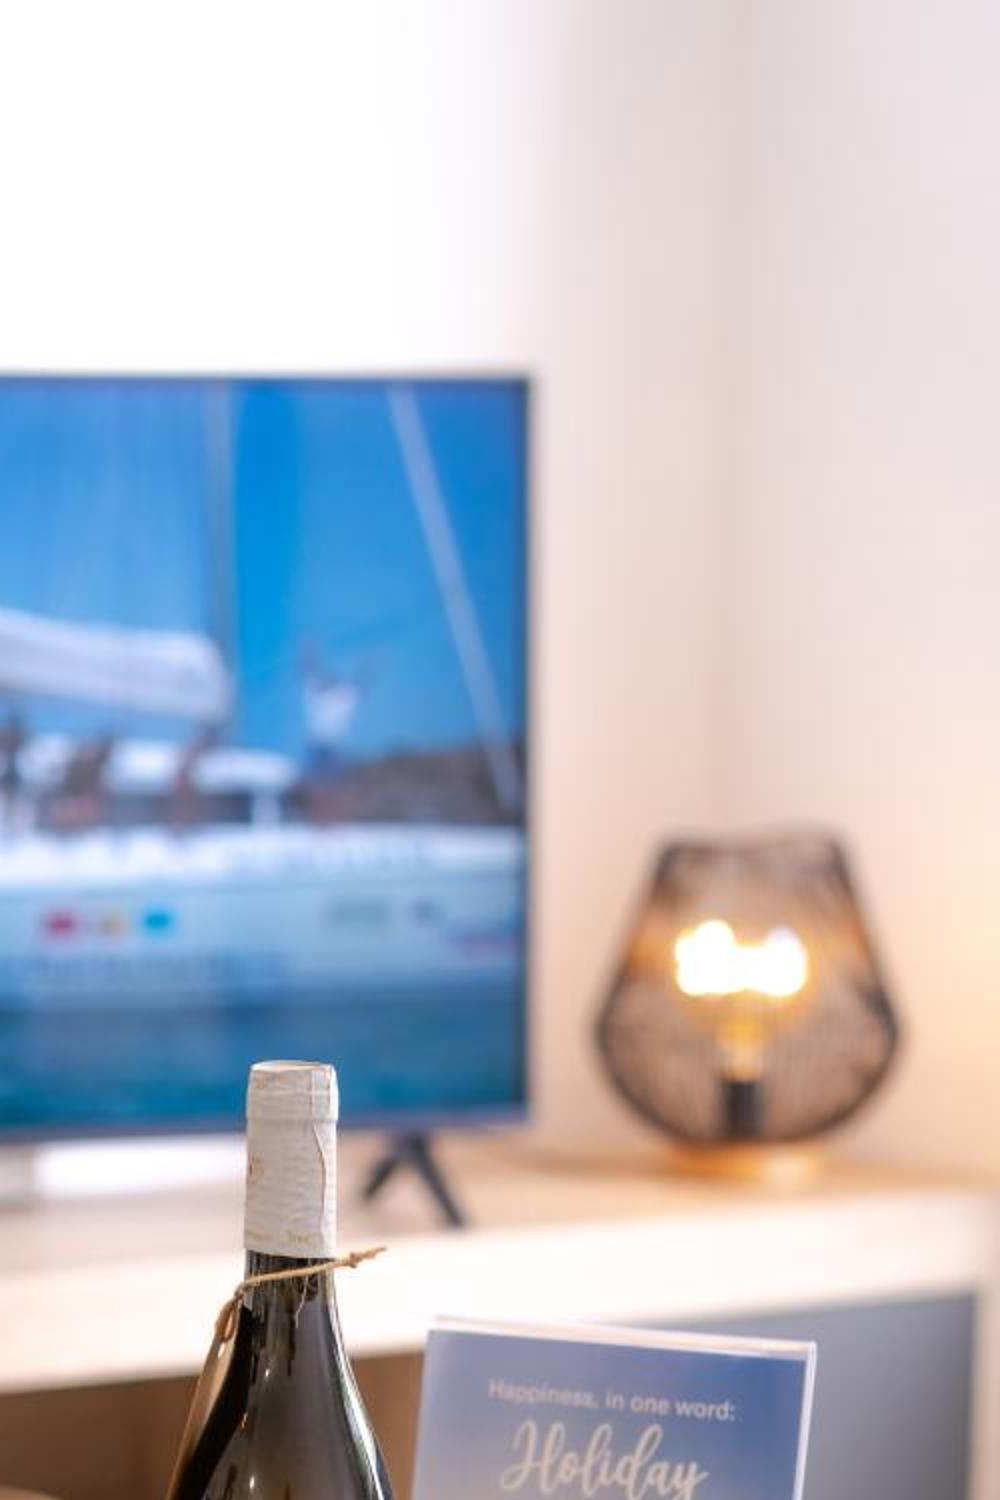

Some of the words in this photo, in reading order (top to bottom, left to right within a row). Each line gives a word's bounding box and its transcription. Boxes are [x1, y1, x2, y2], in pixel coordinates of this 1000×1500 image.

[605, 1391, 625, 1412] in
[630, 1397, 670, 1416] one
[676, 1400, 737, 1422] word:
